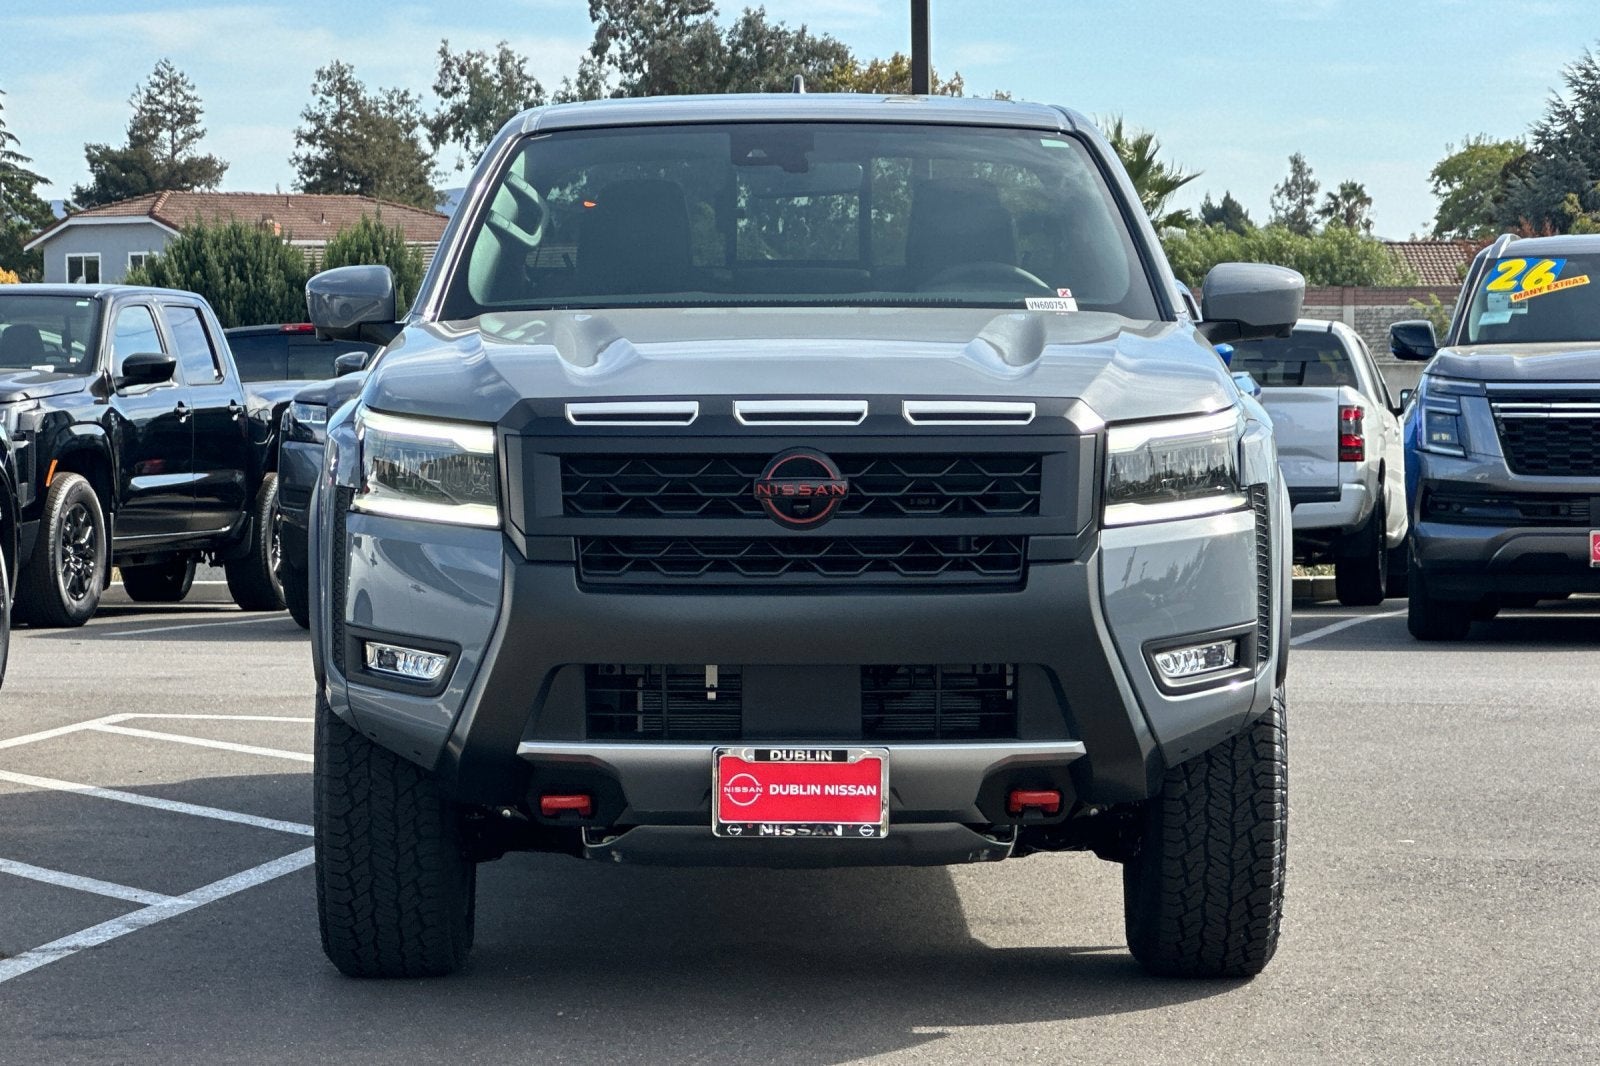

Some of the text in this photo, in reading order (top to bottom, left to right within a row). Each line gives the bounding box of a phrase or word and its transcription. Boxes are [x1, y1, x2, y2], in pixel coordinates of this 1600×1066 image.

[1487, 259, 1556, 291] 26
[1513, 276, 1586, 301] MANY EXTRAS
[757, 484, 845, 496] NISSAN
[770, 750, 832, 761] DUBLIN
[769, 784, 877, 796] DUBLIN NISSAN
[759, 824, 843, 836] NISSAN
